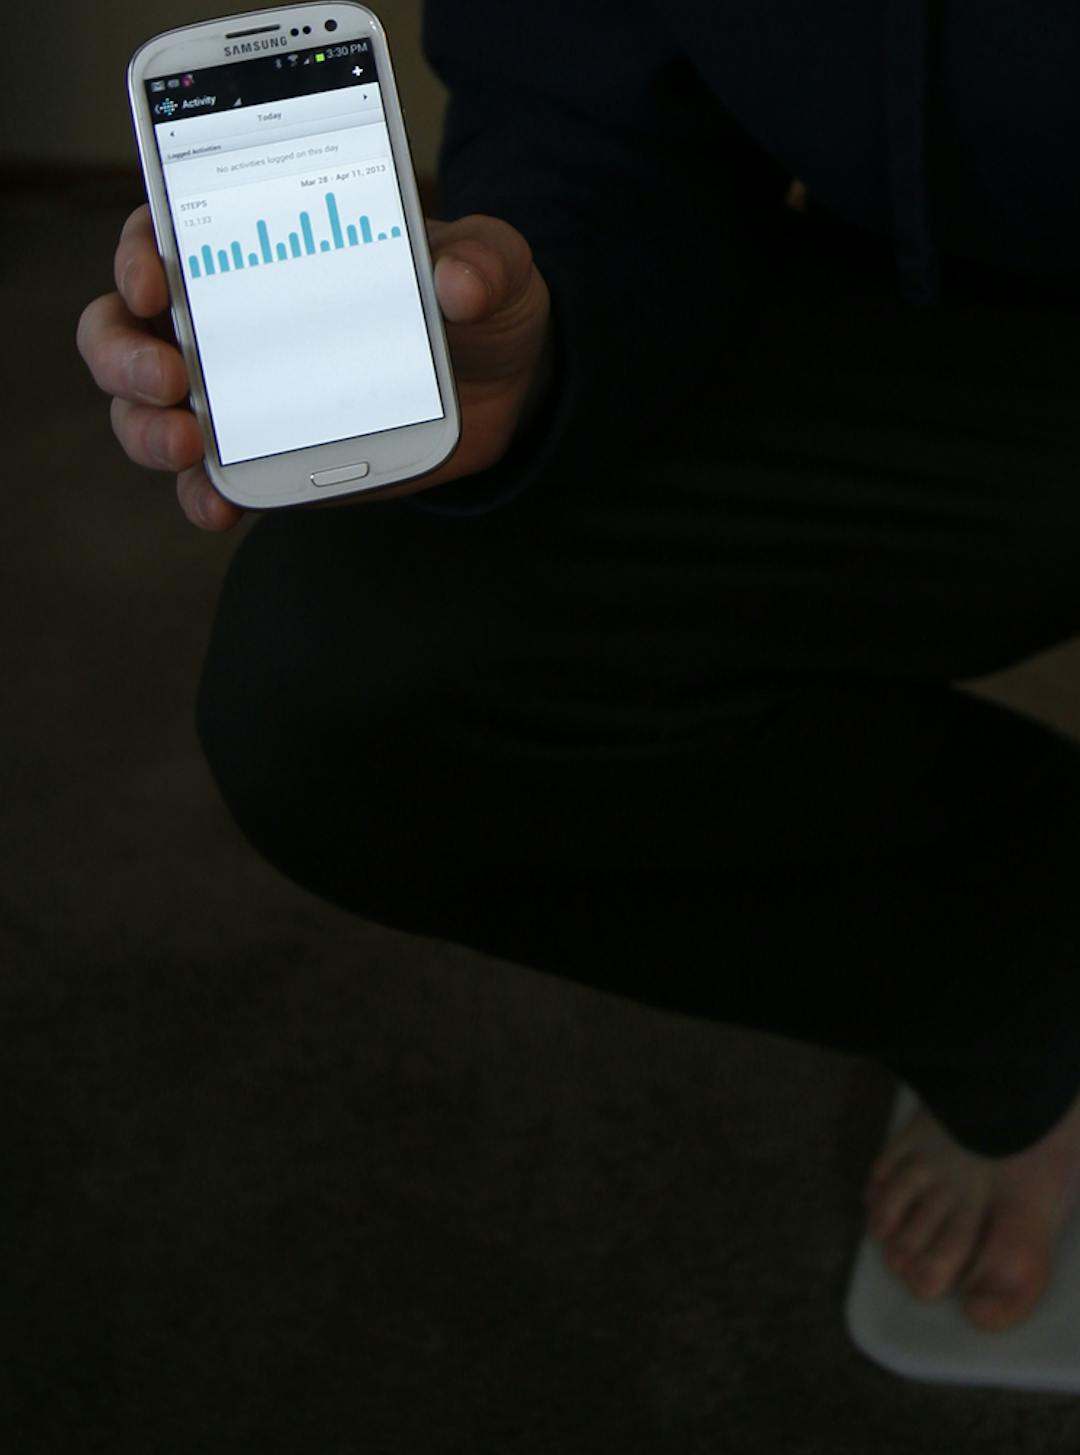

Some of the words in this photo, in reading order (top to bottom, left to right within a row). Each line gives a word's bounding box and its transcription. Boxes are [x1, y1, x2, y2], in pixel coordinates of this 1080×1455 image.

[224, 36, 288, 57] SAMSUNG
[326, 45, 349, 58] 3:30
[350, 42, 368, 55] PM
[182, 95, 216, 109] Activity
[257, 111, 282, 122] Today
[216, 166, 229, 174] No
[231, 158, 266, 171] activities
[267, 151, 295, 164] logged
[296, 151, 306, 159] on
[307, 146, 323, 156] this
[324, 144, 339, 154] day
[301, 179, 316, 187] Mar
[335, 173, 350, 181] Apr
[366, 164, 386, 175] 2013
[180, 200, 208, 211] STEPS
